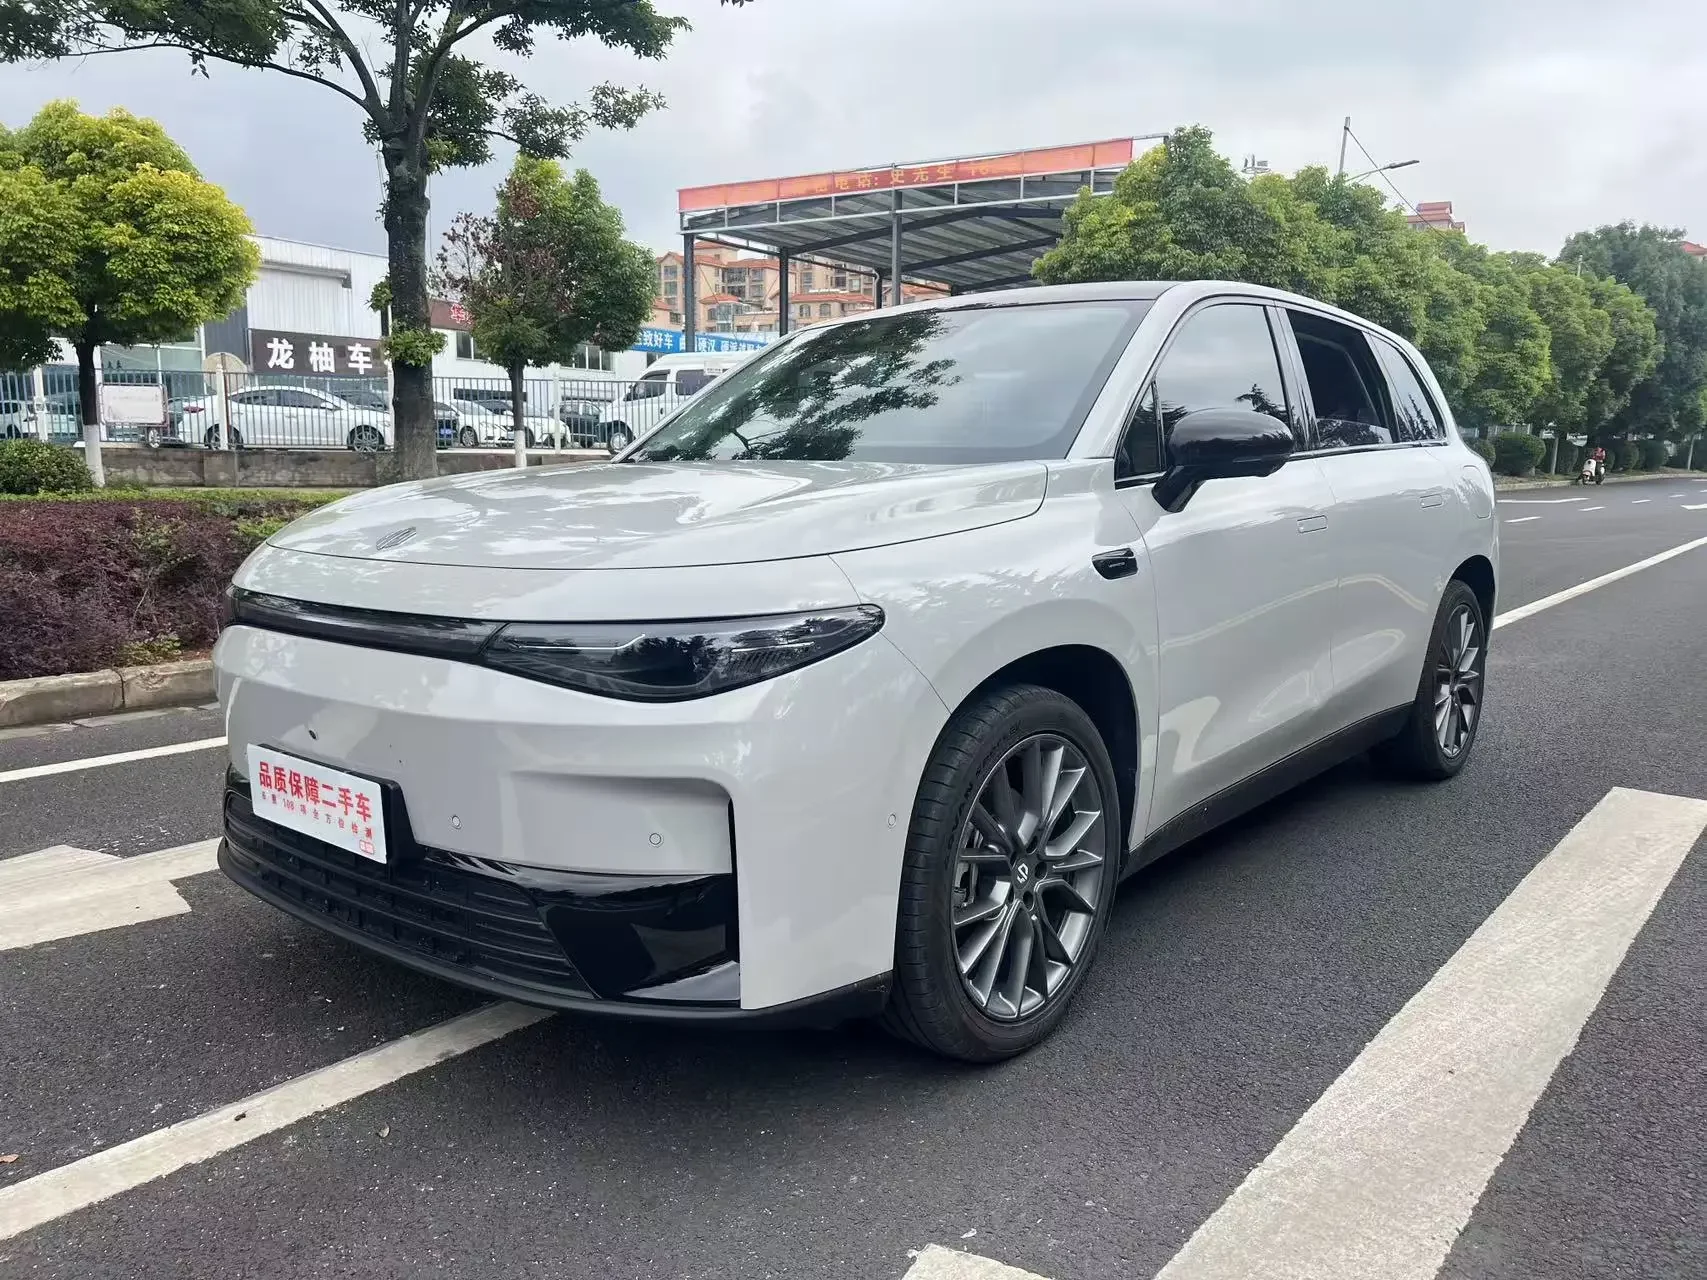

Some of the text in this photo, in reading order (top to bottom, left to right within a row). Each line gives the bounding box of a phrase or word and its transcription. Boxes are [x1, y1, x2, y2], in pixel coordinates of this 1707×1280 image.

[258, 761, 372, 822] 品质保障二手车
